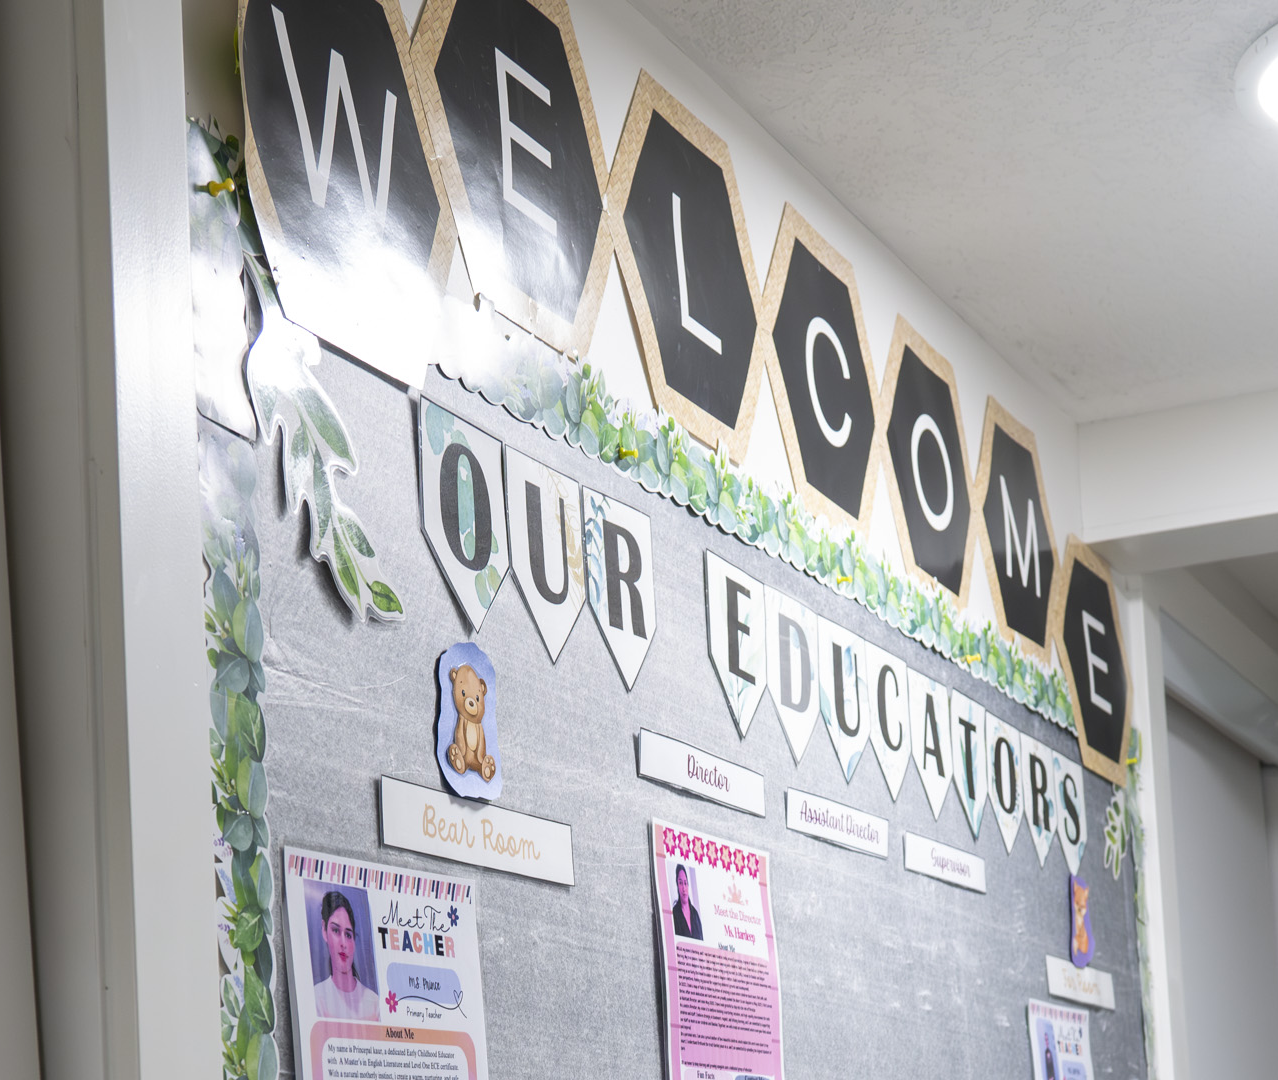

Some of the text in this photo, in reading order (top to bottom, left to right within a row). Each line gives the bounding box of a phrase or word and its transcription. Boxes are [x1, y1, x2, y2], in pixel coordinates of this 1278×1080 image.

[271, 4, 1112, 712] WELCOME
[439, 442, 1082, 849] OUR EDUCATORS
[687, 754, 730, 792] Director
[423, 803, 541, 860] Bear Room
[800, 800, 880, 844] Assistant Director
[931, 847, 971, 878] Supervisor
[382, 900, 450, 932] Meet The
[378, 926, 456, 958] TEACHER
[407, 1006, 442, 1022] Primary Teacher
[385, 1028, 414, 1040] About Me
